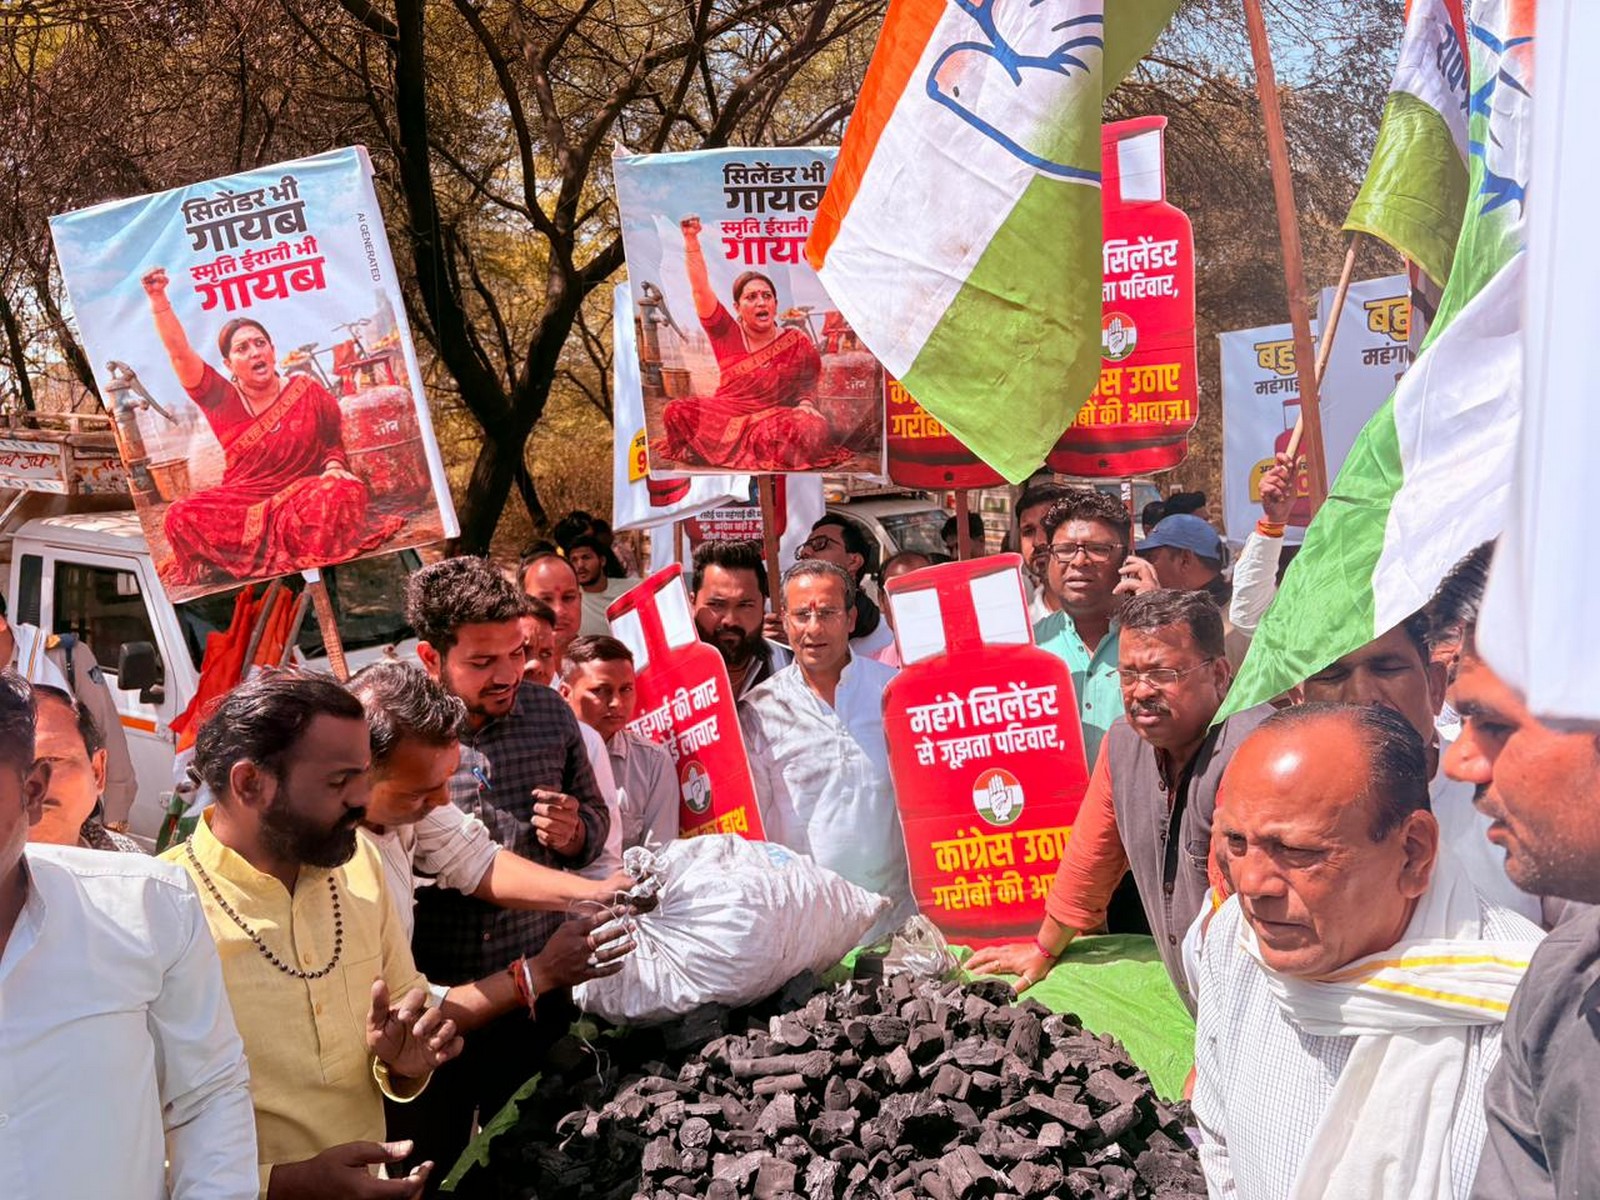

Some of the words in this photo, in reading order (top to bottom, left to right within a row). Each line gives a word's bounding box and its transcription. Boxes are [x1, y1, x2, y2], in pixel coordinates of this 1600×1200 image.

[722, 161, 797, 185] सिलेंडर
[800, 160, 826, 183] भी
[181, 189, 265, 225] सिलेंडर
[270, 175, 299, 201] भी
[357, 212, 366, 223] AI
[186, 201, 307, 252] गायब
[721, 216, 761, 239] स्मृति
[763, 216, 809, 236] ईरानी
[190, 255, 237, 284] स्मृति
[239, 242, 291, 273] ईरानी
[293, 235, 318, 254] भी
[359, 223, 381, 282] GENERATED
[722, 236, 808, 265] गाय
[1102, 235, 1179, 275] सिलेंडर
[195, 256, 327, 311] गायब
[1119, 272, 1179, 299] परिवार,
[1125, 362, 1181, 393] उठाए
[1098, 397, 1122, 425] की
[672, 686, 693, 721] की
[690, 676, 720, 710] मार
[906, 691, 966, 734] महंगे
[967, 680, 1059, 727] सिलेंडर
[677, 714, 720, 756] लाचार
[914, 736, 936, 765] से
[936, 734, 992, 769] जूझता
[993, 722, 1066, 754] परिवार,
[931, 826, 1016, 873] कांग्रेस
[1016, 825, 1073, 863] उठा
[931, 873, 993, 911] गरीबों
[993, 869, 1025, 905] की
